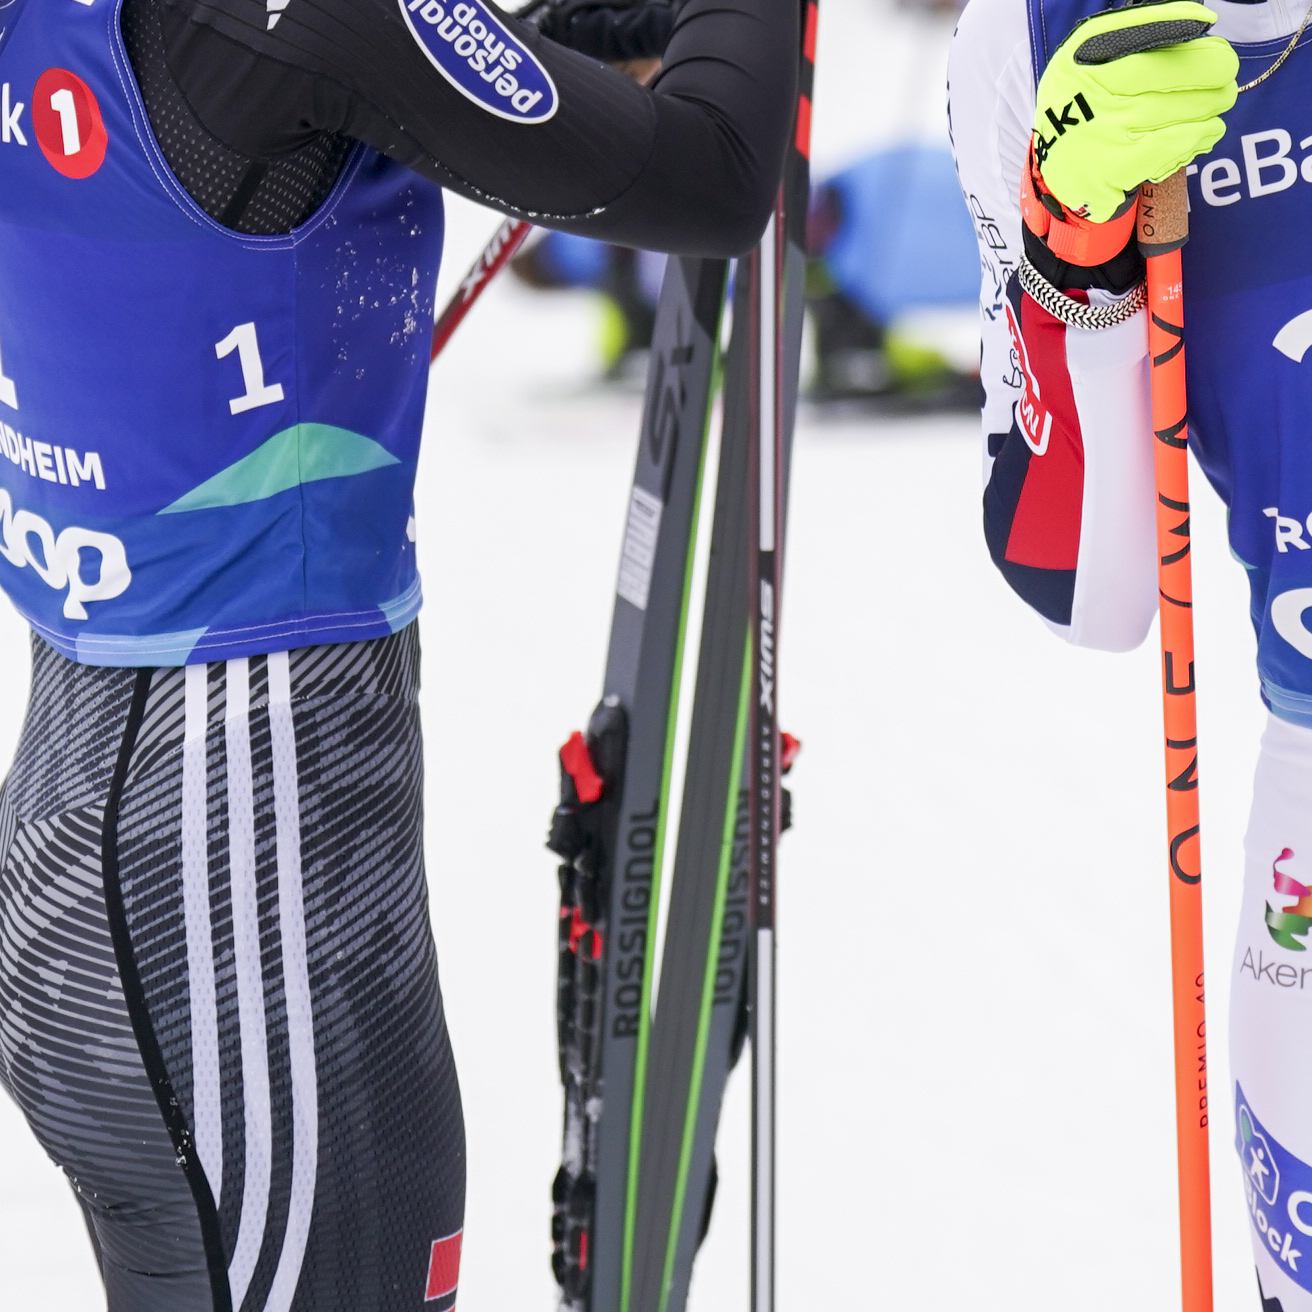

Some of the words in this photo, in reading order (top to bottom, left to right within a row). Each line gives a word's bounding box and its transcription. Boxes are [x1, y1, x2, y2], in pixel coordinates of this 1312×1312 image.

[452, 2, 523, 71] shop
[50, 88, 81, 156] 1
[214, 322, 285, 415] 1
